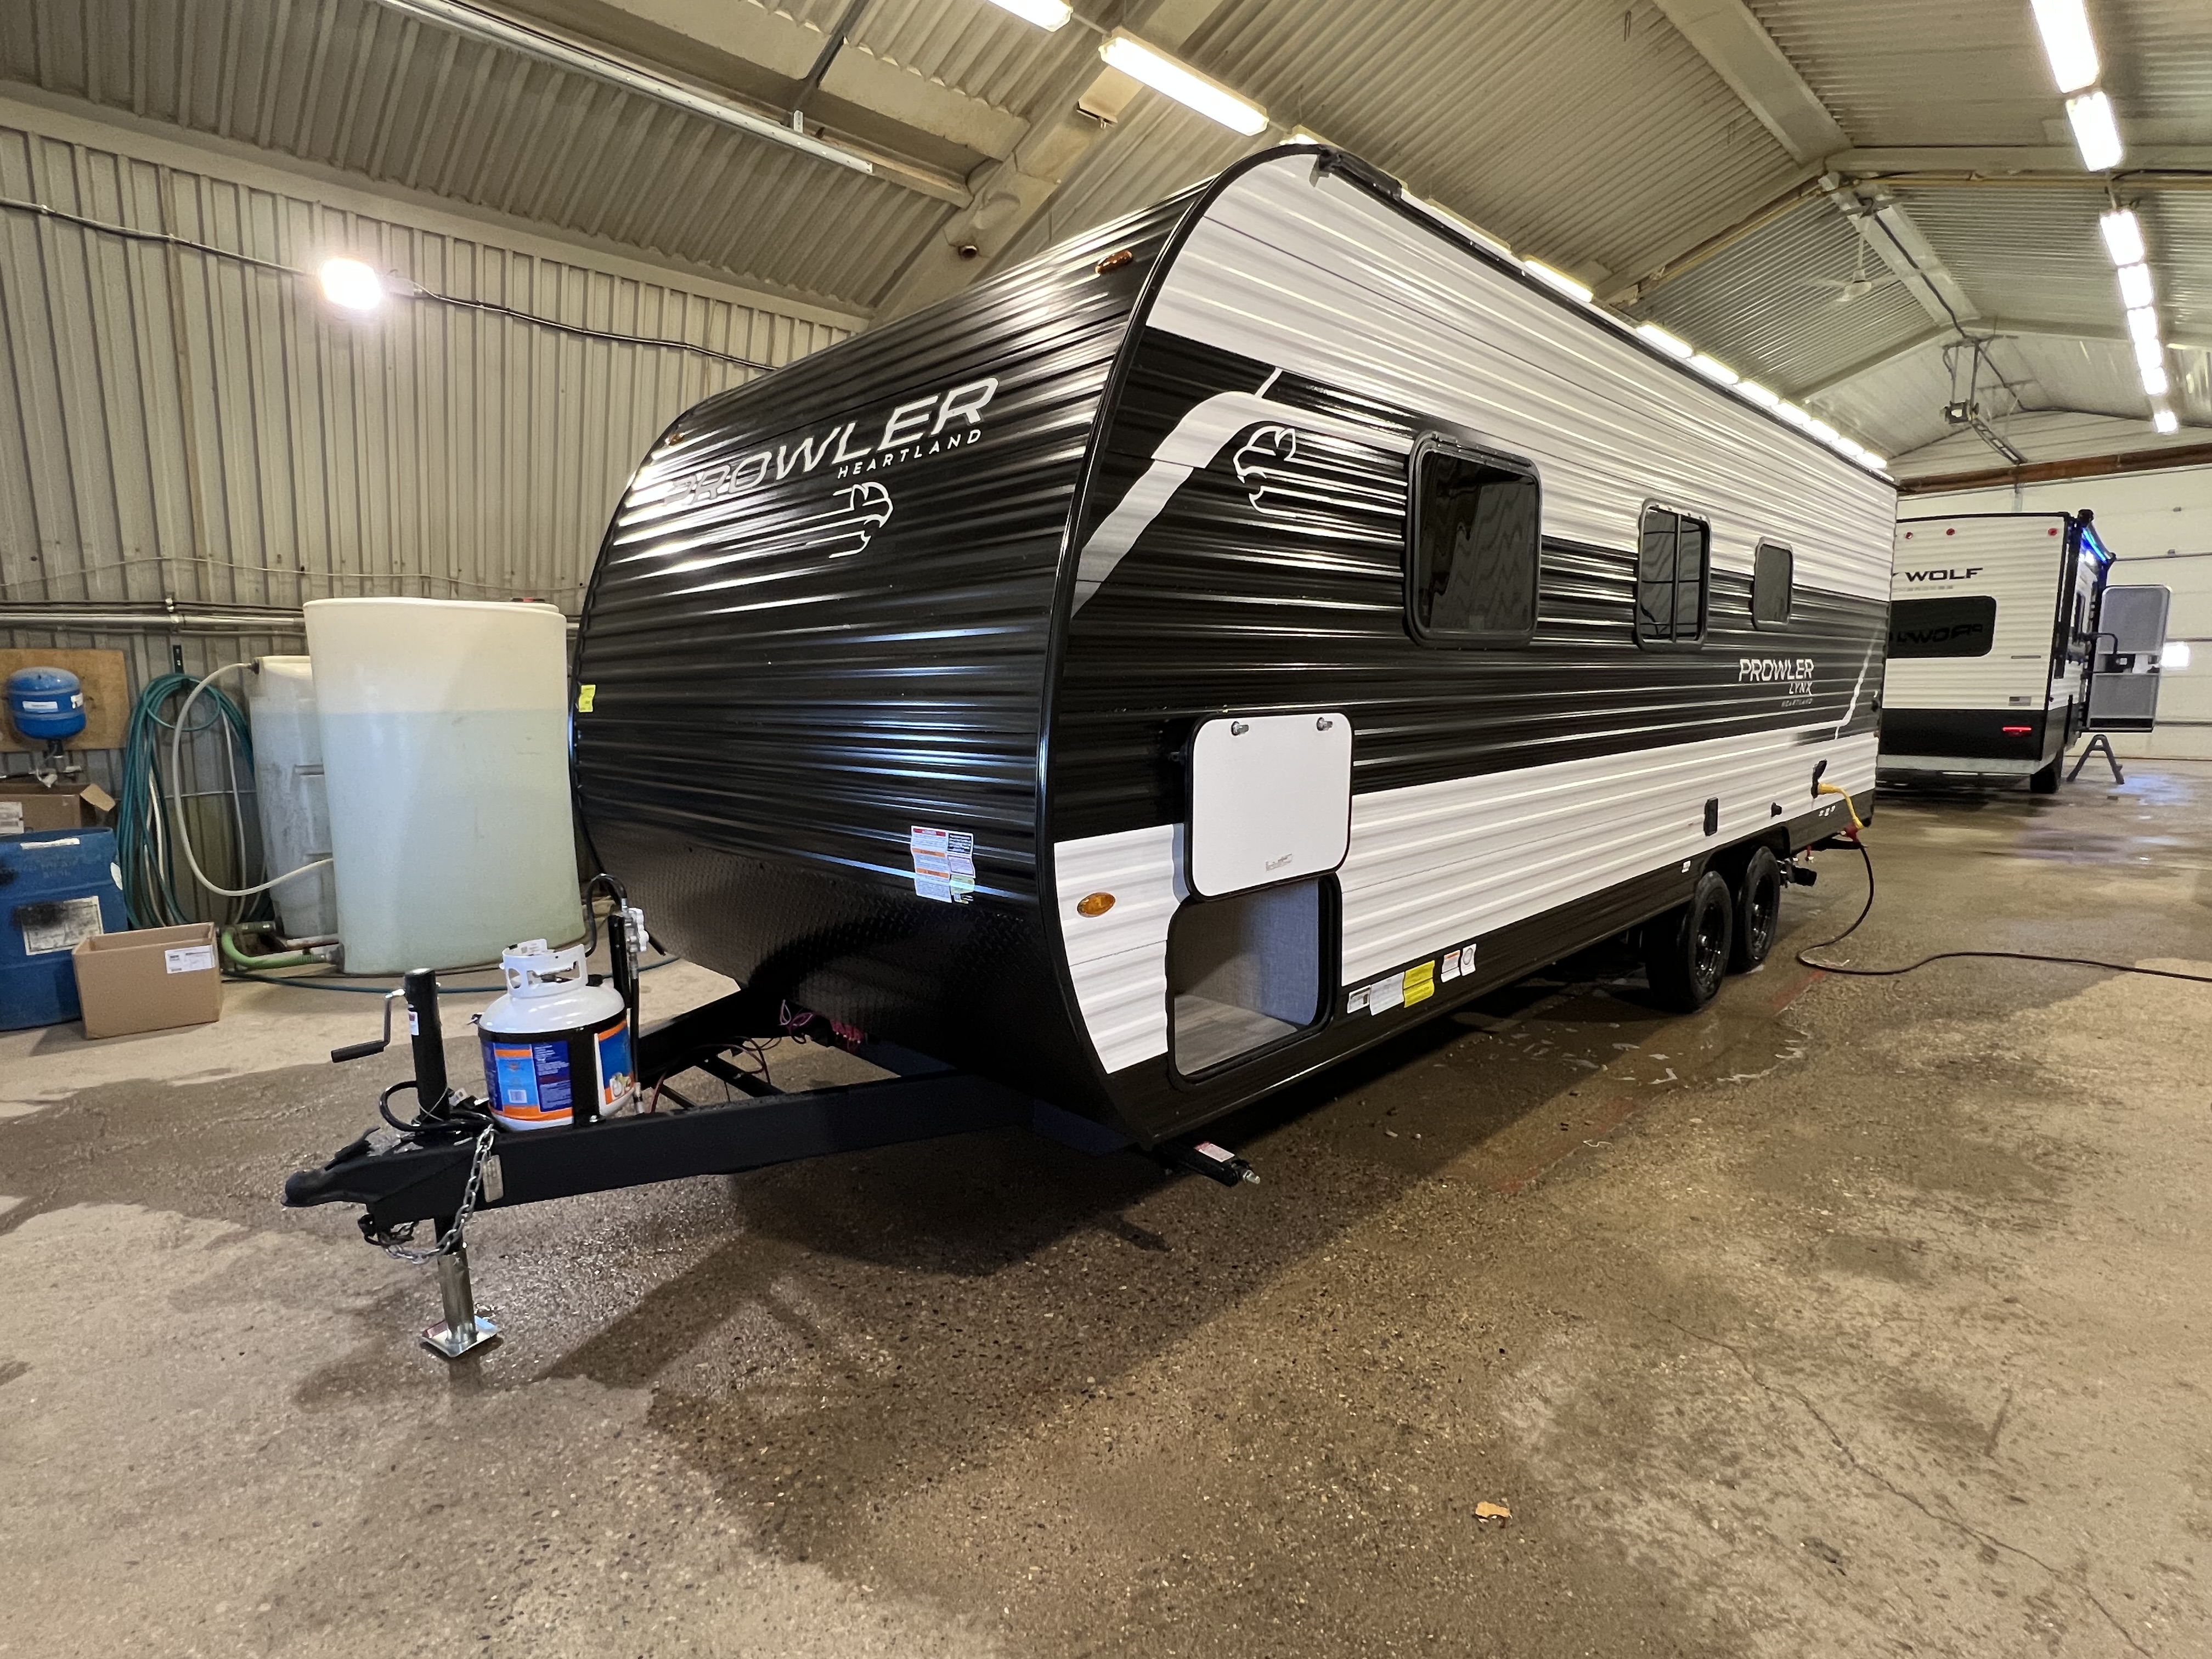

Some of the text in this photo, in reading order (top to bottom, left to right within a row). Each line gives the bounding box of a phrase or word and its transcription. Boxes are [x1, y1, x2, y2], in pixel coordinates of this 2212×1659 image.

[664, 377, 999, 506] PROWLER
[837, 430, 981, 479] HEARTLAND
[1905, 567, 1983, 582] WOLF
[1738, 658, 1814, 682] PROWLER
[1788, 682, 1813, 695] LYNX
